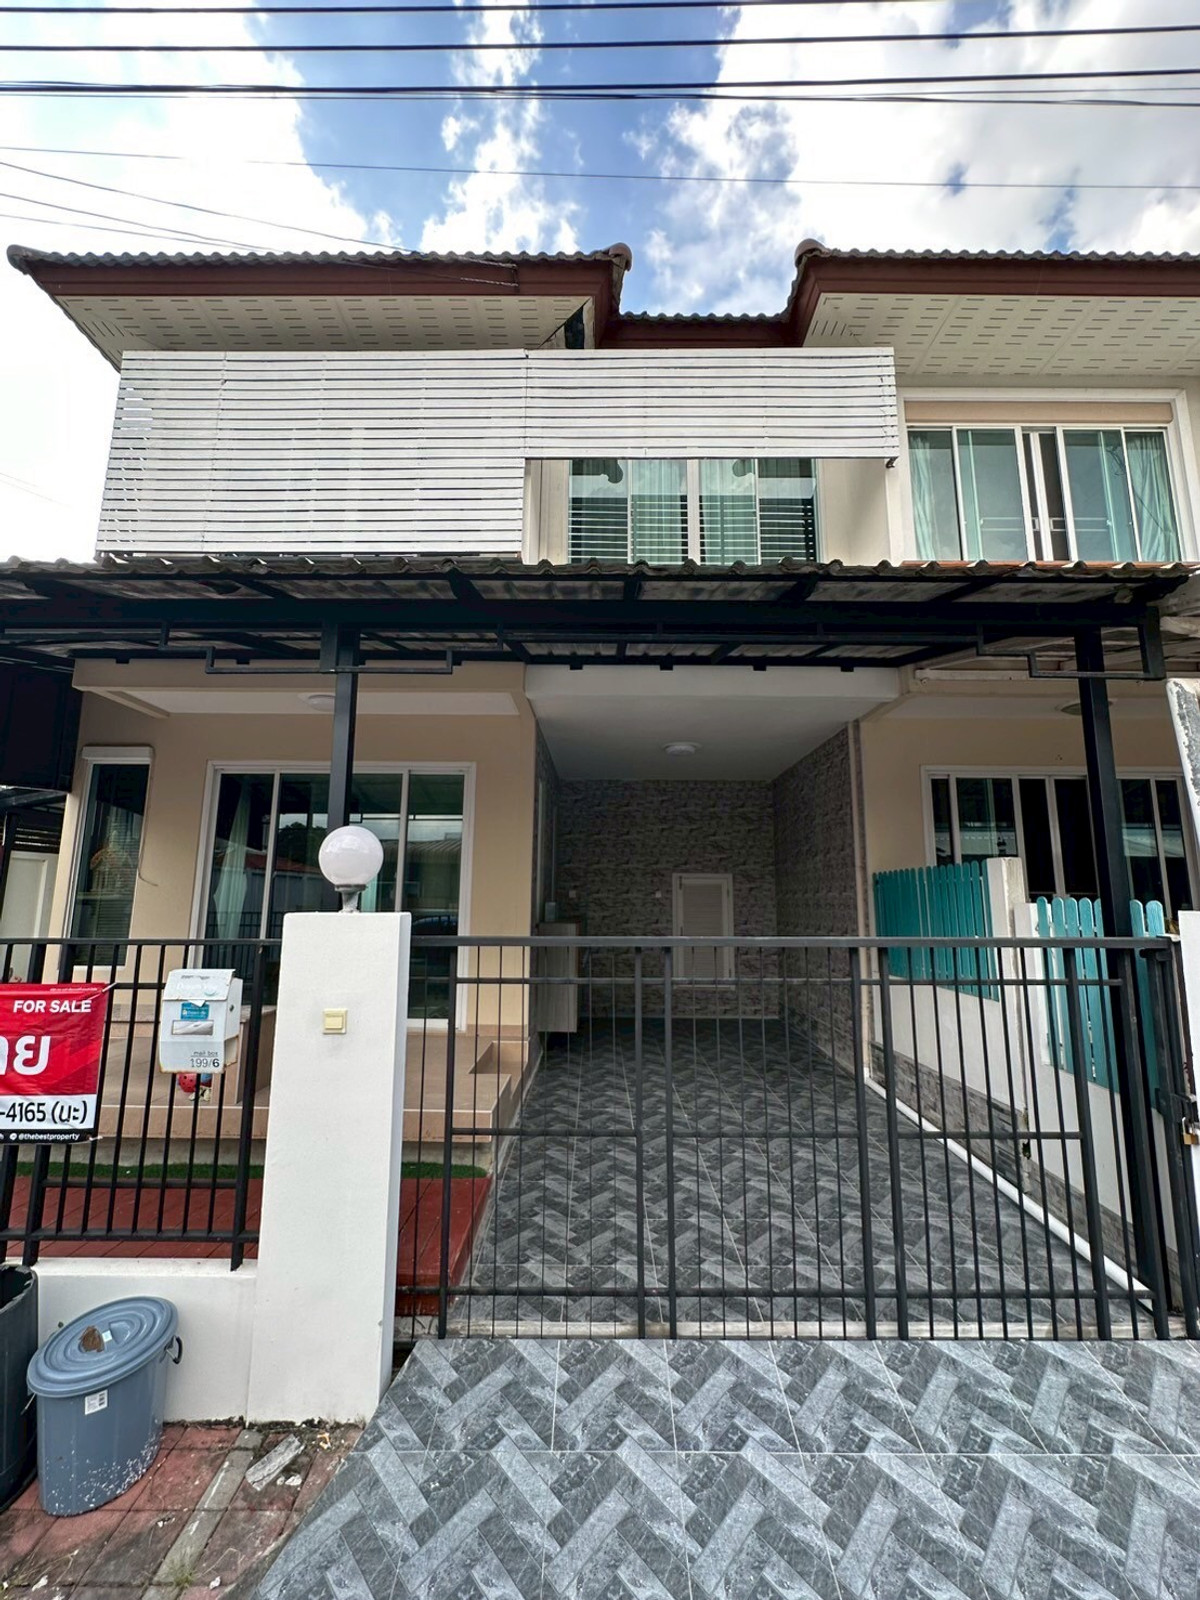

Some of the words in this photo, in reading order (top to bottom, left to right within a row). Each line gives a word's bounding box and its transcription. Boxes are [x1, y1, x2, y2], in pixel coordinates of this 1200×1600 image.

[13, 999, 46, 1013] FOR
[49, 999, 92, 1013] SALE
[190, 1058, 220, 1068] 199/6
[18, 1132, 80, 1141] @thebestproperty
